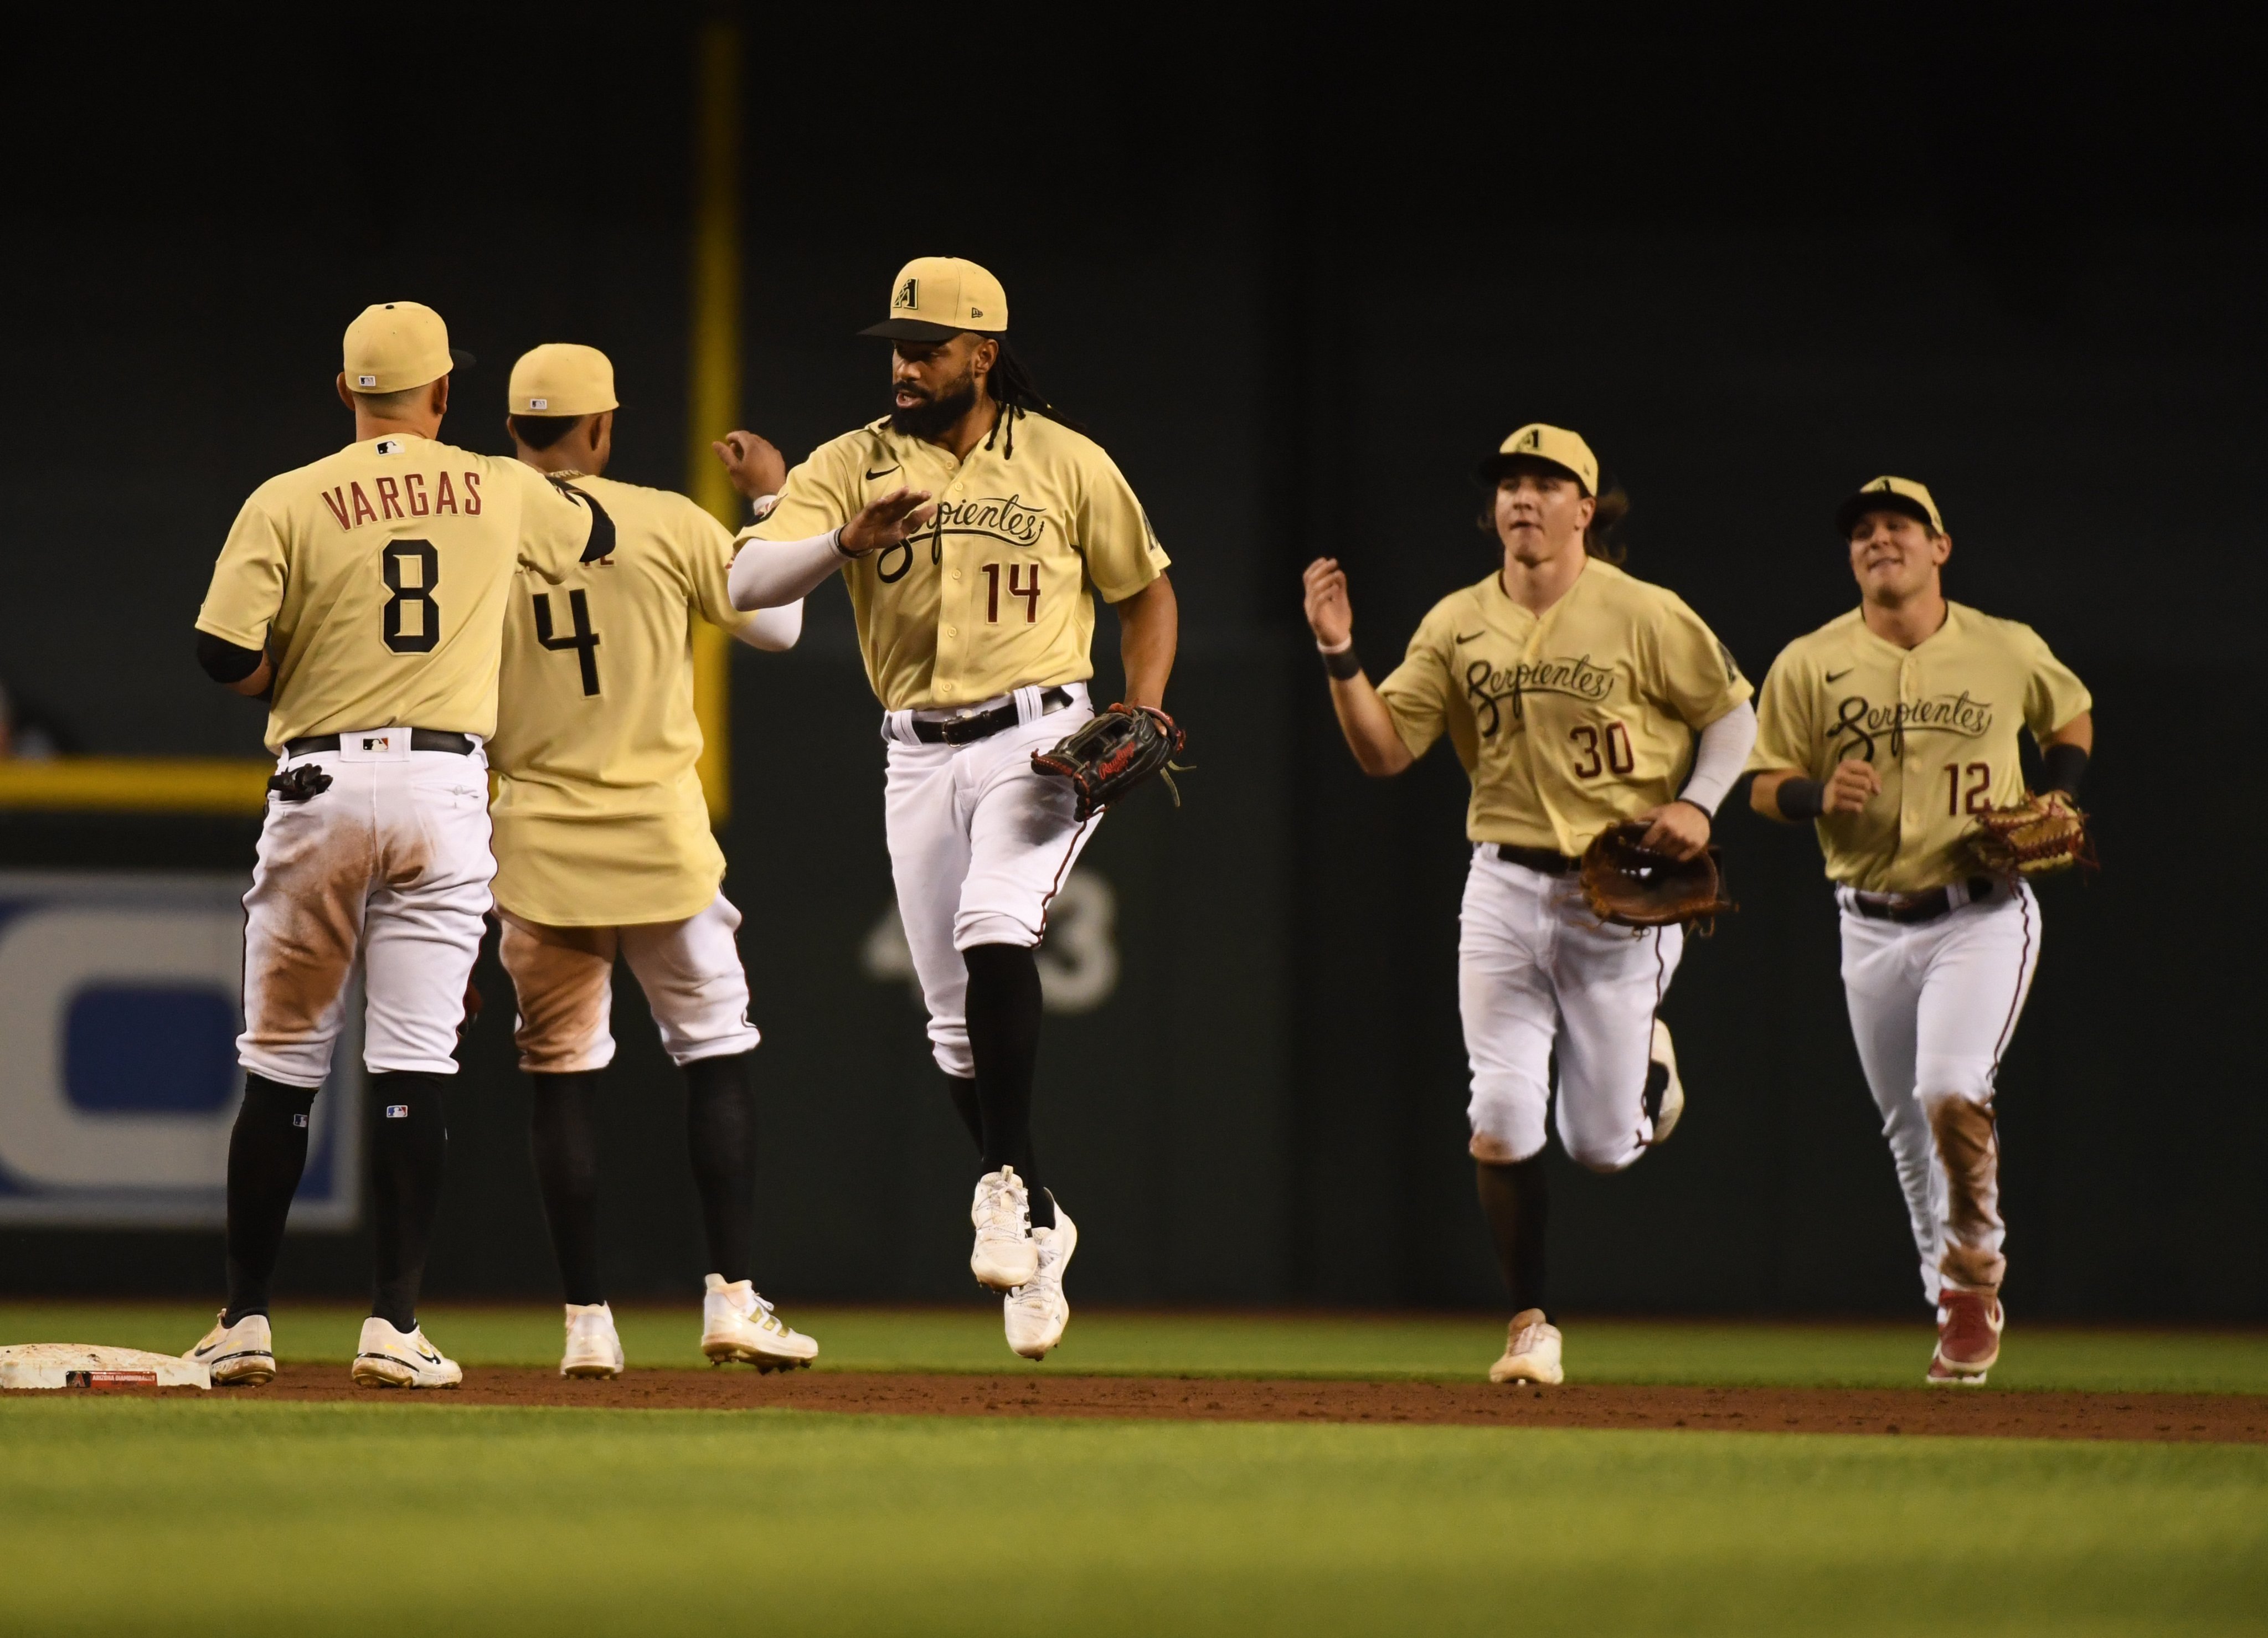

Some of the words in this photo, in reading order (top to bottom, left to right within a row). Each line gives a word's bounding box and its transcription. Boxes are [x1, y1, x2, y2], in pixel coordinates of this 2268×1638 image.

[321, 471, 482, 533] VARGAS
[877, 493, 1047, 584] rpientes
[380, 537, 441, 656] 8
[981, 563, 1041, 624] 14
[532, 588, 601, 698] 4
[1466, 653, 1614, 738] Serpientes
[1826, 689, 1992, 763] Serpientes
[1569, 720, 1635, 779] 30
[1944, 761, 1992, 817] 12
